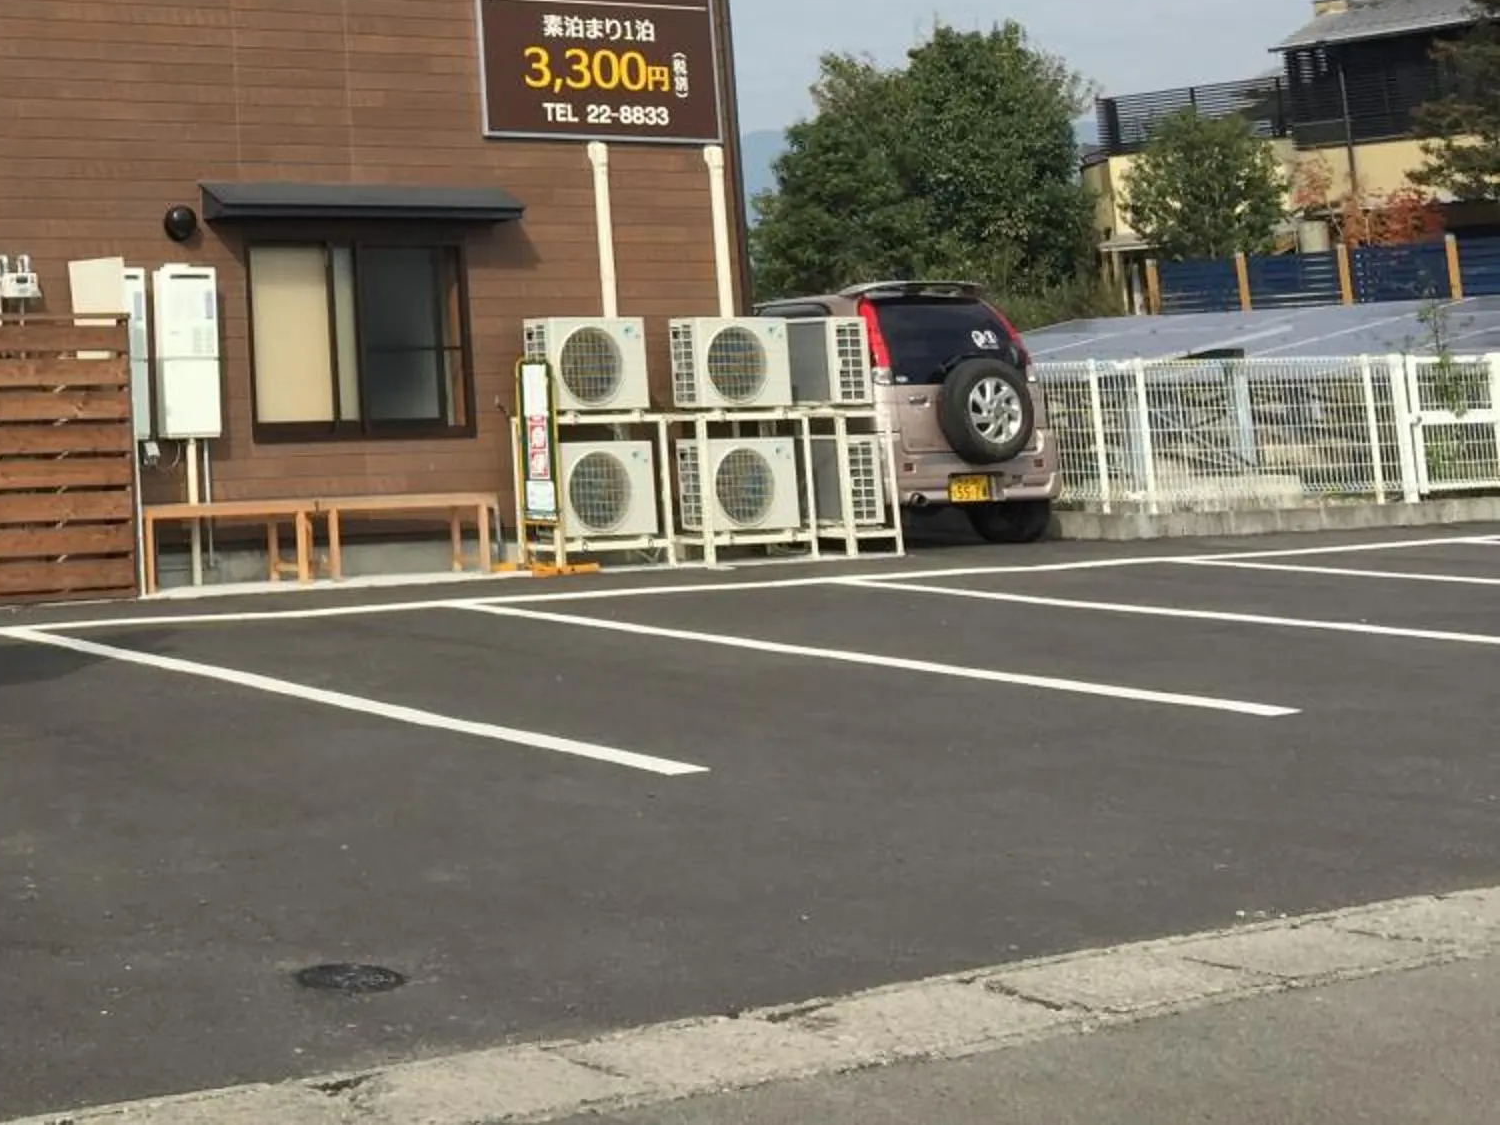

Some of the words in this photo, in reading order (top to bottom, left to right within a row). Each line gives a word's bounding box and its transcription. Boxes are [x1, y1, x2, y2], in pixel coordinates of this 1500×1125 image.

[543, 14, 655, 43] 素泊まり1泊
[523, 46, 671, 94] 3,300円
[542, 102, 579, 122] TEL
[586, 104, 669, 126] 22-8833
